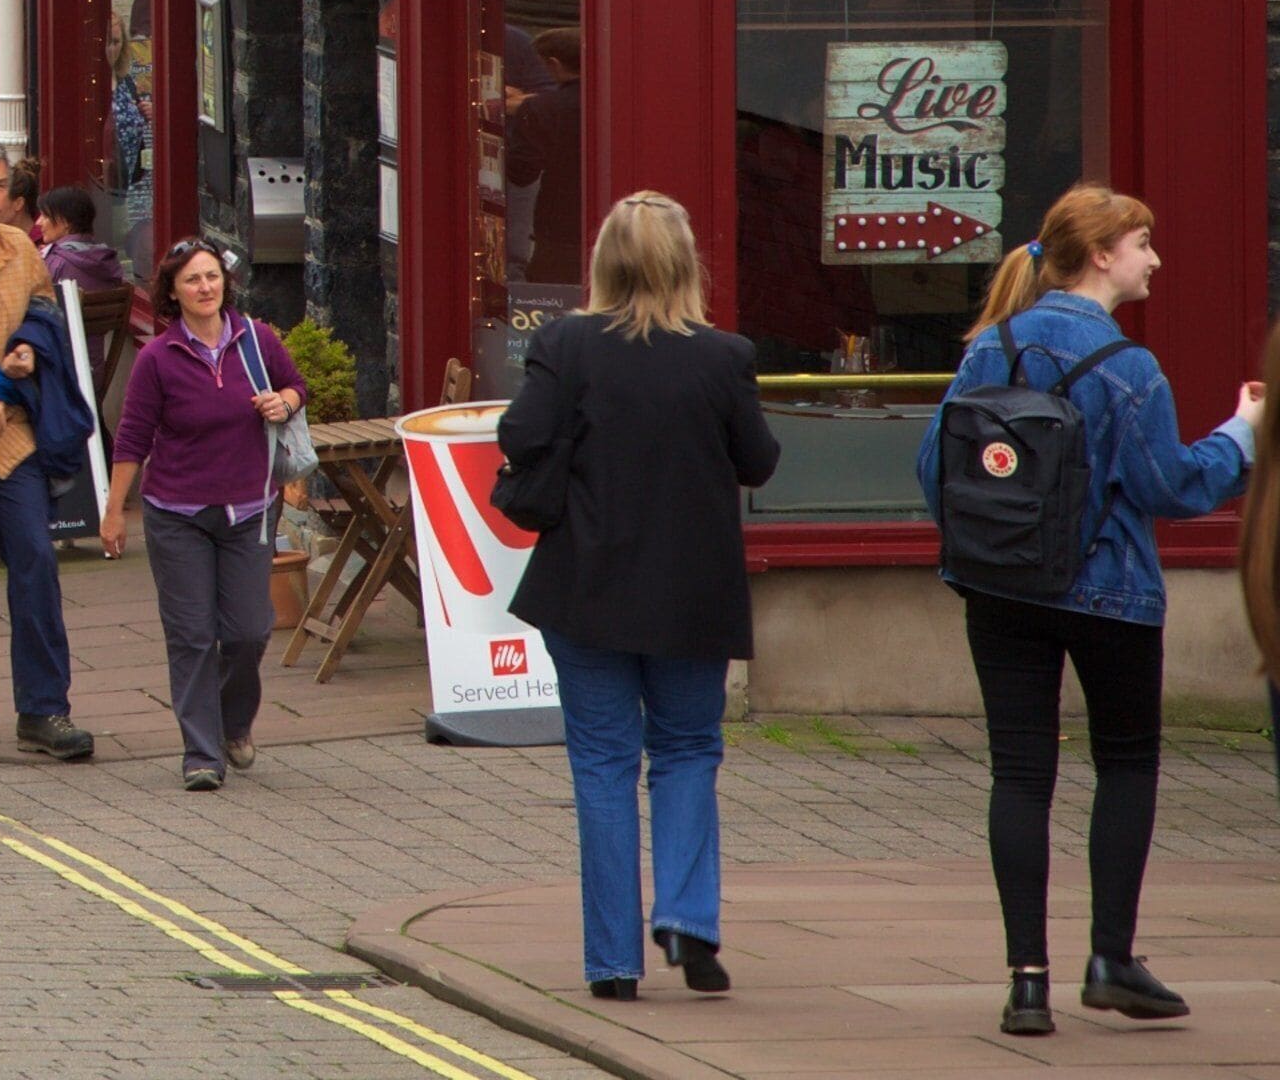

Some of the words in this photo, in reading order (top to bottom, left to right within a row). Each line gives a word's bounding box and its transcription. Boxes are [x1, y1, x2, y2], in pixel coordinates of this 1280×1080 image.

[857, 57, 998, 135] Live
[834, 133, 992, 190] Music
[494, 645, 524, 672] illy
[452, 680, 518, 703] Served
